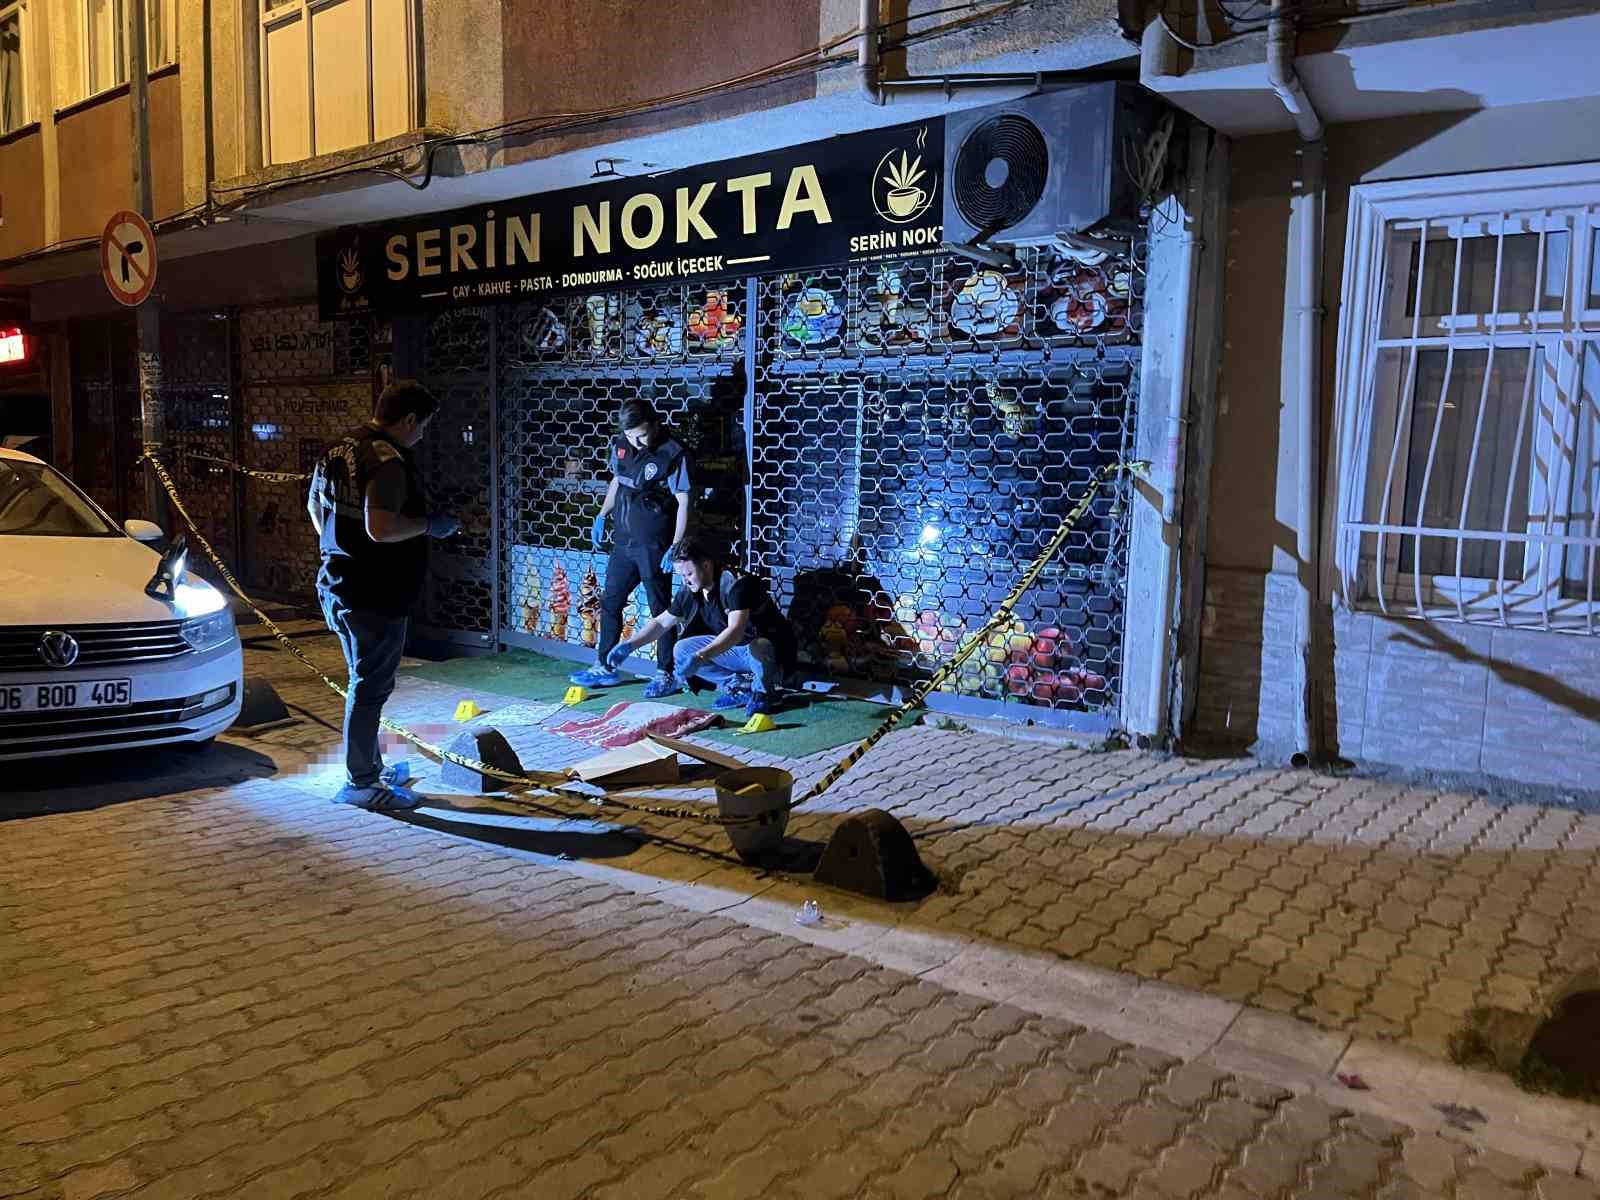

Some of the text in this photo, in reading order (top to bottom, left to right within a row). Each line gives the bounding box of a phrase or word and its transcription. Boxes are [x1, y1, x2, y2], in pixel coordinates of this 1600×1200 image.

[385, 164, 832, 282] SERİN NOKTA
[850, 226, 944, 252] SERİN NOK
[478, 280, 511, 296] KAHVE
[520, 276, 553, 292] PASTA
[562, 268, 623, 287] DONDURMA
[633, 261, 674, 280] SOĞUK
[677, 255, 723, 277] İÇECEK
[38, 685, 76, 708] BOD
[91, 682, 129, 705] 405
